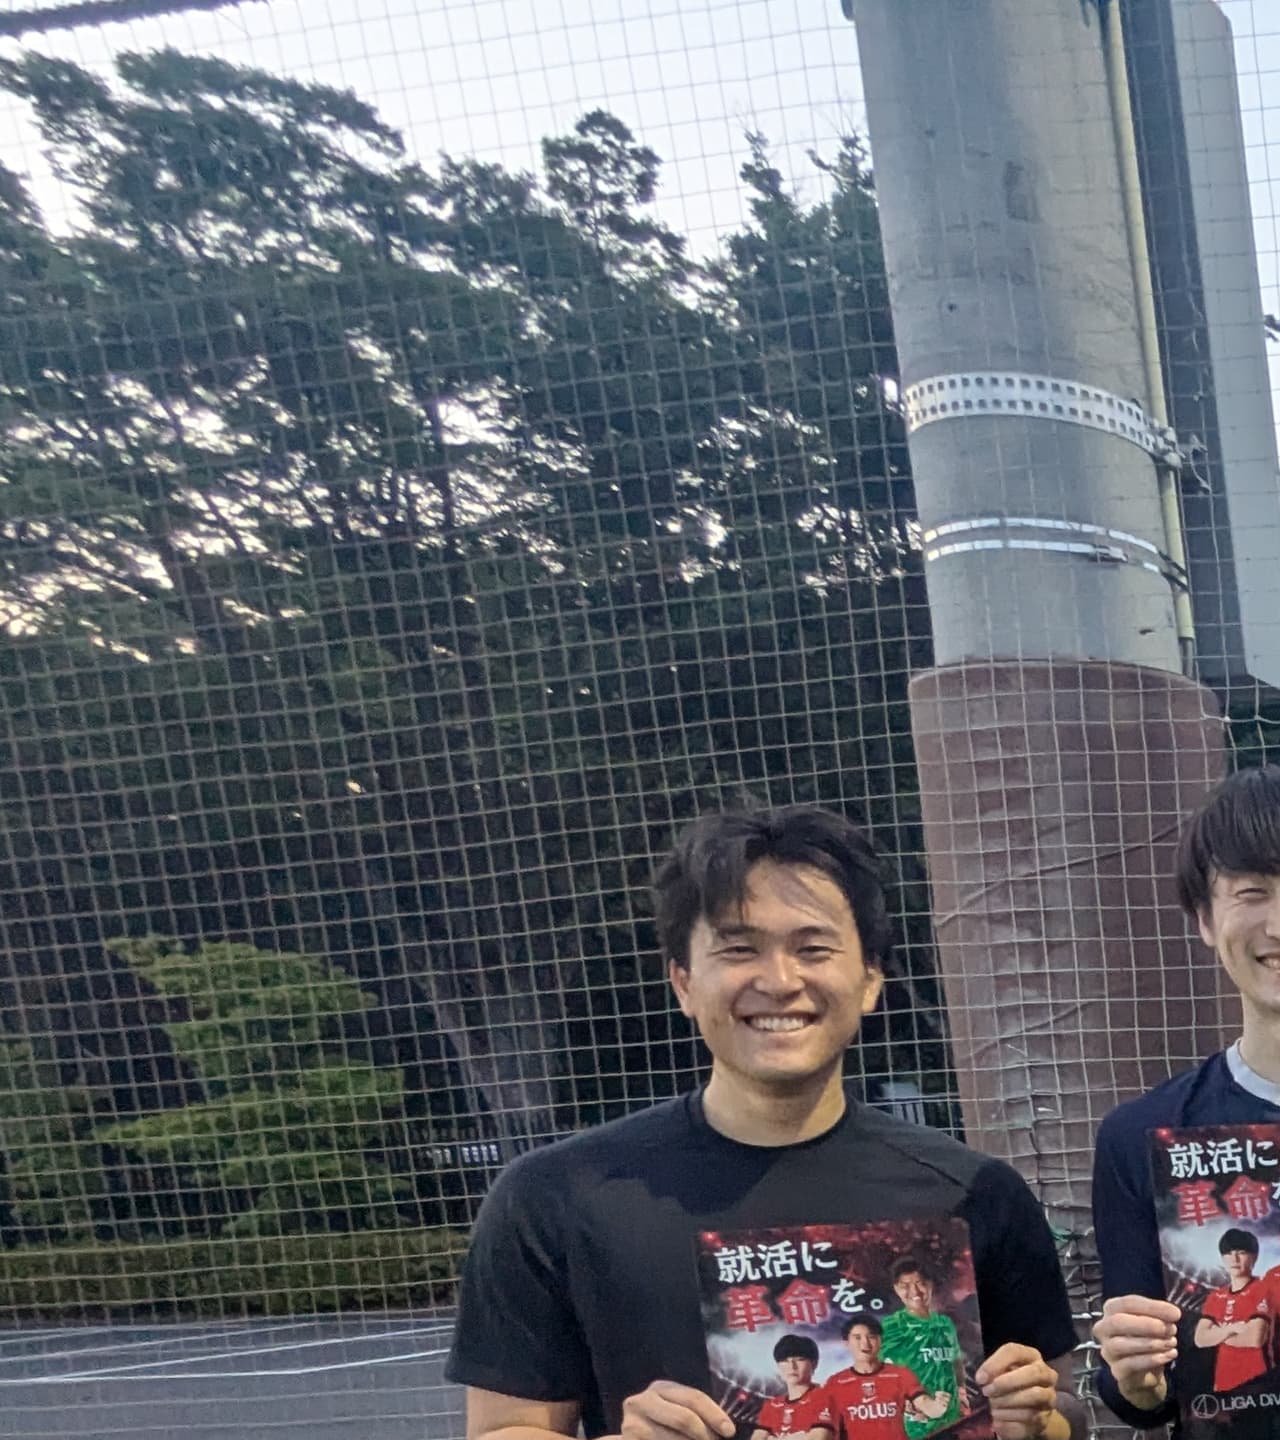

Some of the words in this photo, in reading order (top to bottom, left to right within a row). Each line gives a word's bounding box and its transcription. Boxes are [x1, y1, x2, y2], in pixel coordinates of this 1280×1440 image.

[1167, 1138, 1279, 1178] 就活に
[713, 1241, 838, 1284] 就活に
[725, 1278, 884, 1333] 革命を。
[847, 1402, 897, 1421] POLUS
